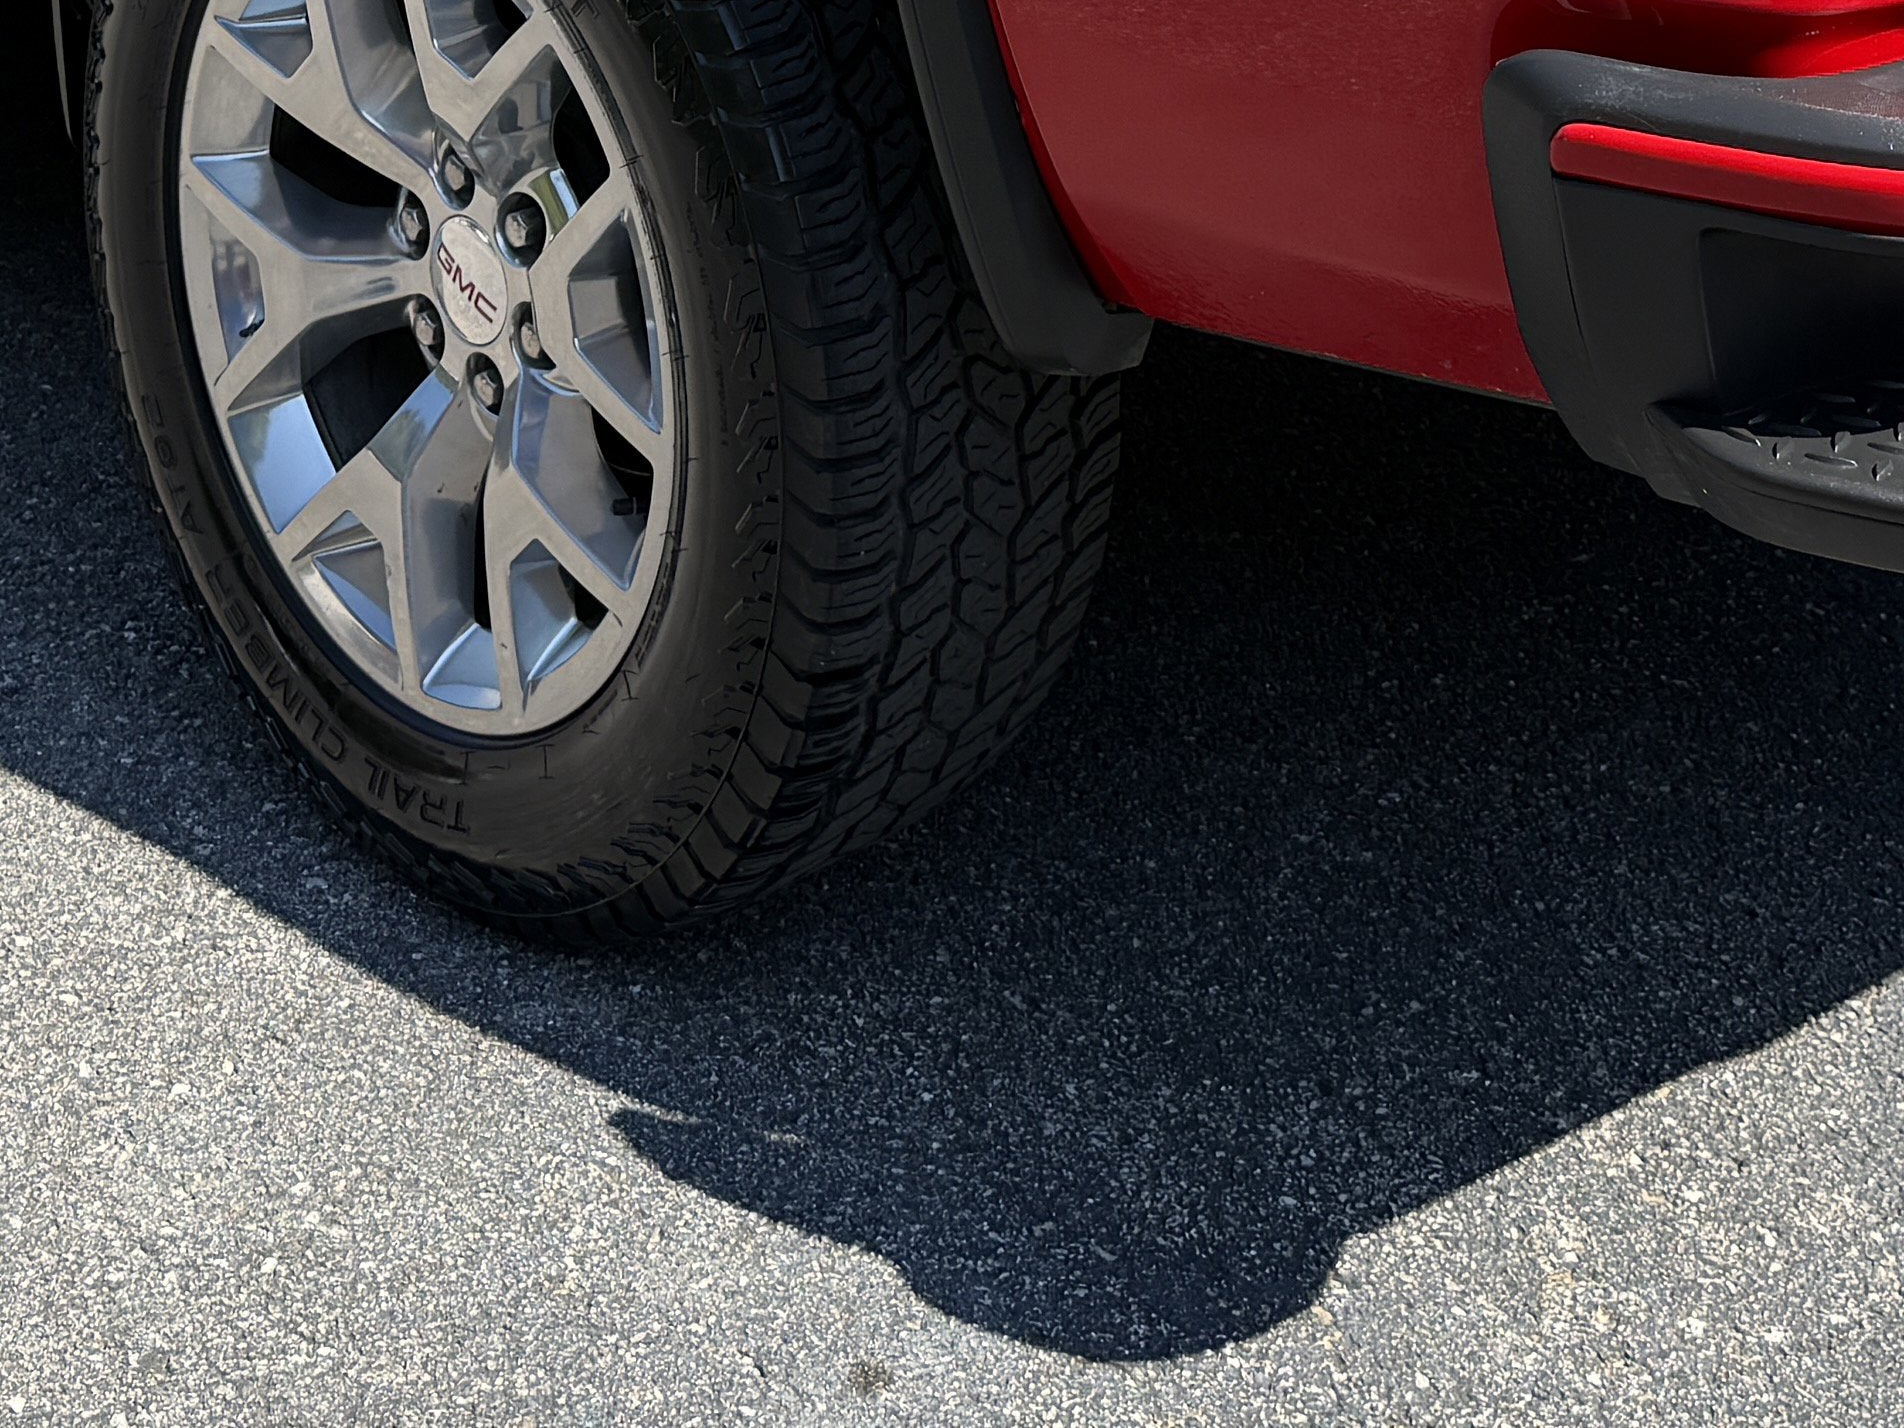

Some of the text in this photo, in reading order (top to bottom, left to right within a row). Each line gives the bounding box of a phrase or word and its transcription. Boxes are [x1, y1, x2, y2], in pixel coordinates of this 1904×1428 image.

[437, 242, 497, 324] GMC
[205, 564, 346, 763] CLIMBER
[364, 756, 471, 834] TRAIL
